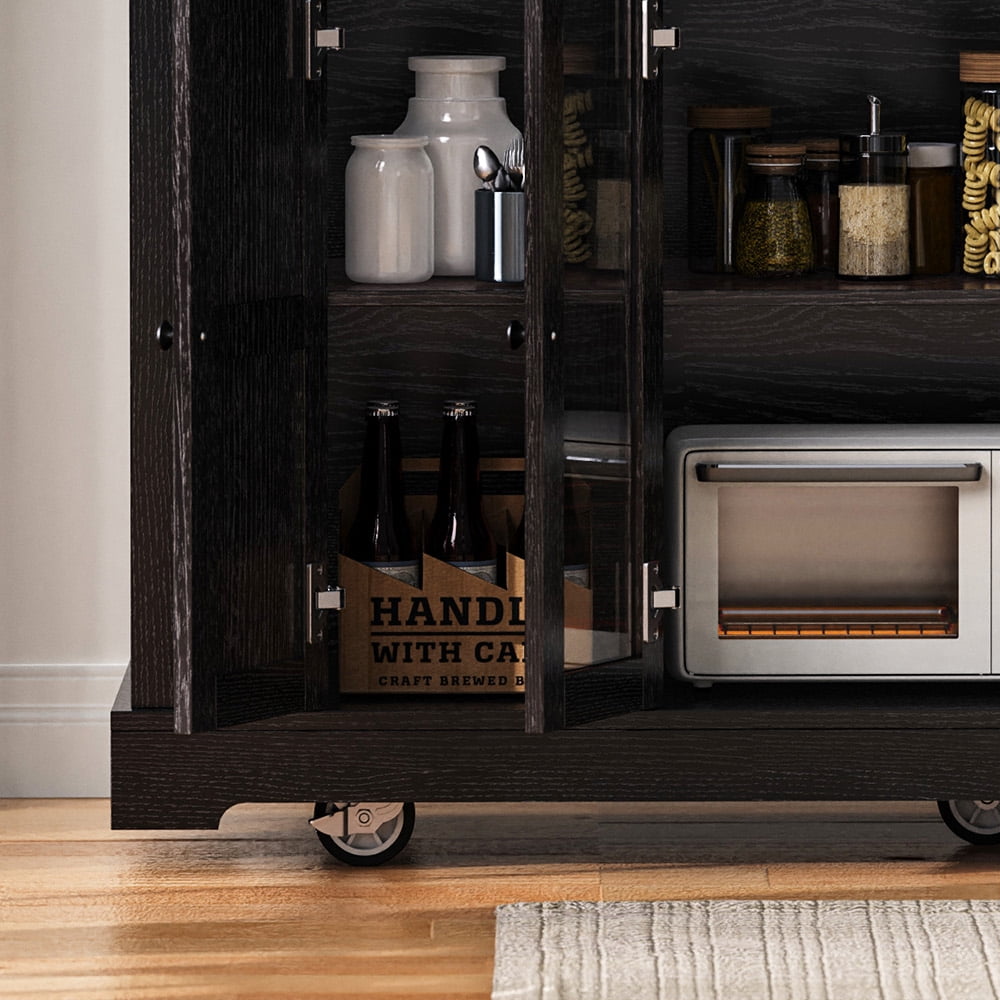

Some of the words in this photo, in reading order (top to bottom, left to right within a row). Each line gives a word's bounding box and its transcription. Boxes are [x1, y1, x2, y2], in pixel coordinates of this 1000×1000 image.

[371, 641, 462, 663] WITH
[474, 641, 525, 663] CA
[378, 675, 433, 686] CRAFT
[440, 675, 508, 686] BREWED
